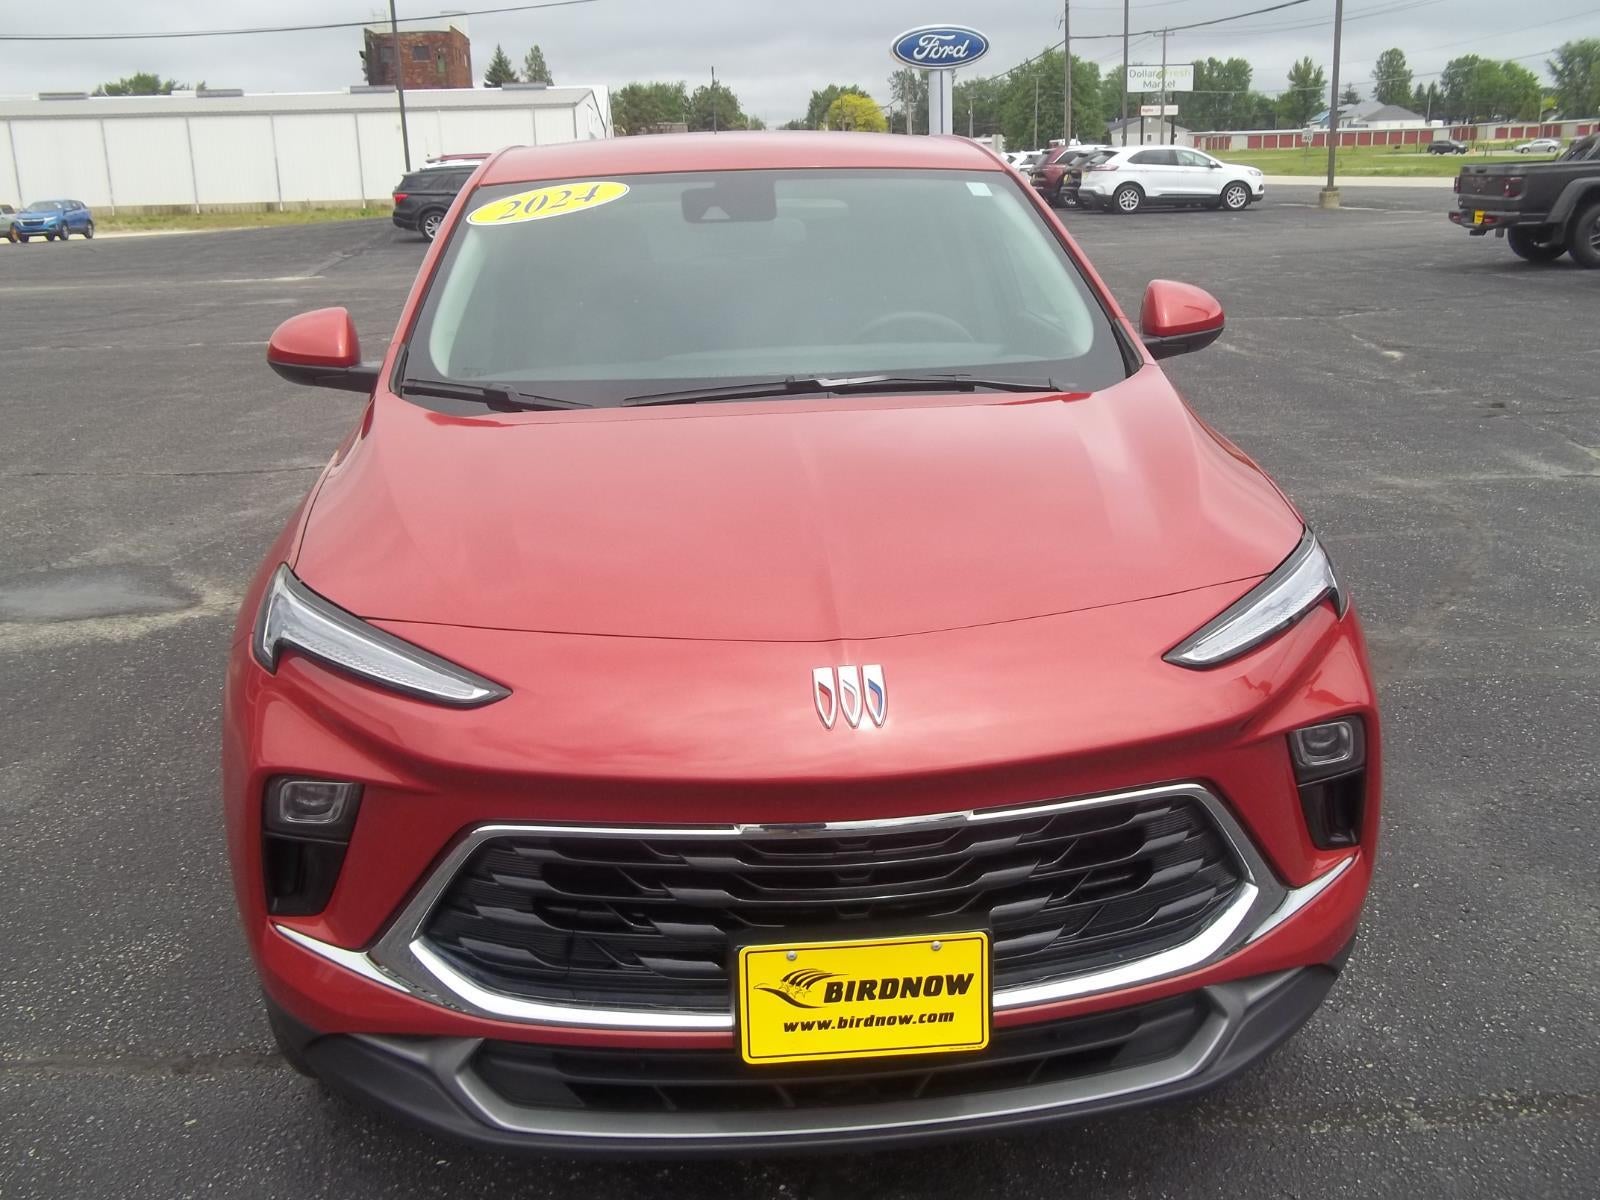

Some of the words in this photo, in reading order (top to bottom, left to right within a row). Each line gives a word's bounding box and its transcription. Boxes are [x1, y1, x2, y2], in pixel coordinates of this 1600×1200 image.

[913, 34, 970, 60] Ford
[1129, 69, 1156, 79] Dollar
[497, 184, 601, 221] 2024
[824, 972, 975, 1004] BIRDNOW
[783, 1011, 955, 1033] www.birdnow.com
